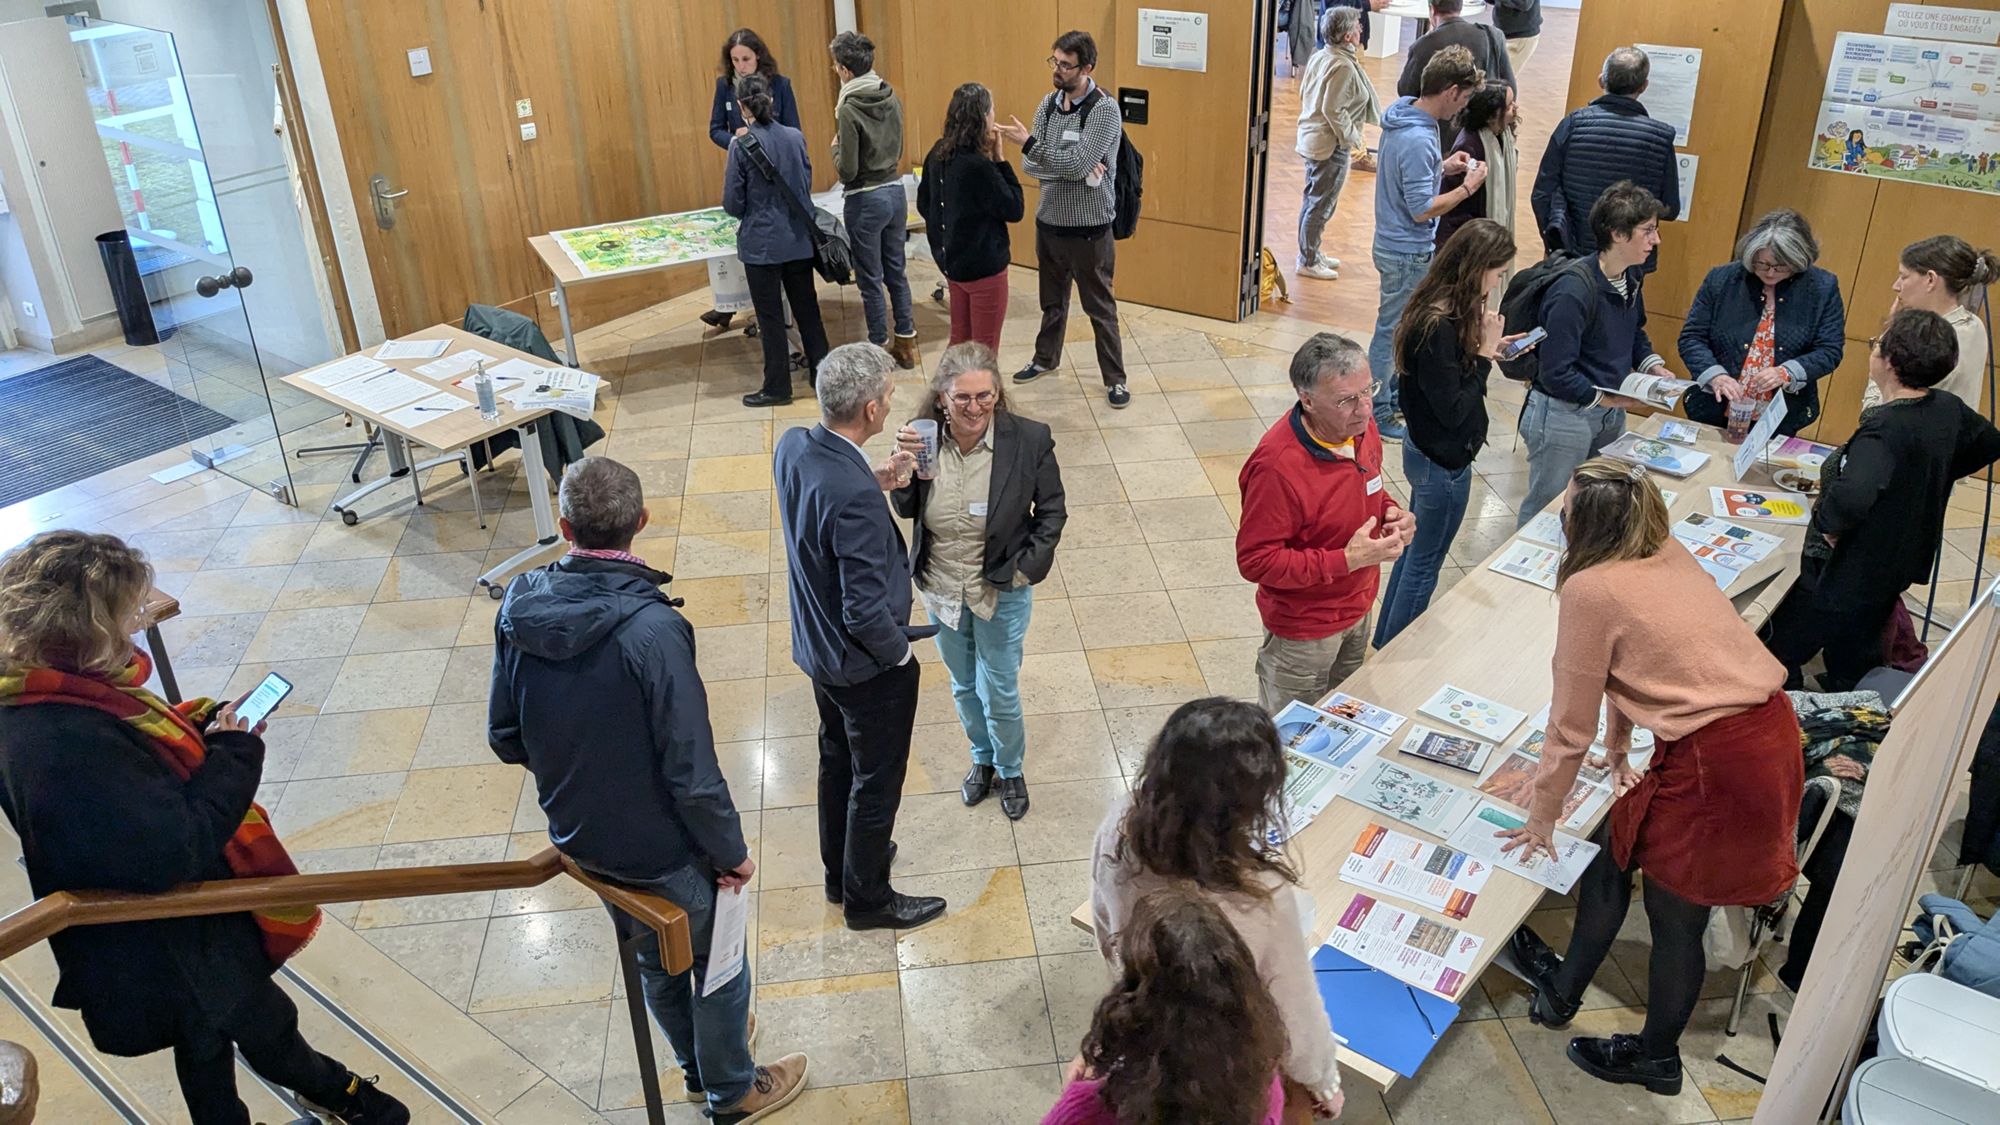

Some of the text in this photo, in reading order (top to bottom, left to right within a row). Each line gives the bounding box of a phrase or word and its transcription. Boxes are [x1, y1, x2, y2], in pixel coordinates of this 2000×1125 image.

[1897, 10, 1924, 20] COLLEZ
[1924, 12, 1940, 21] UNE
[1941, 14, 1980, 25] GOMMETTE
[1910, 21, 1929, 30] VOUS
